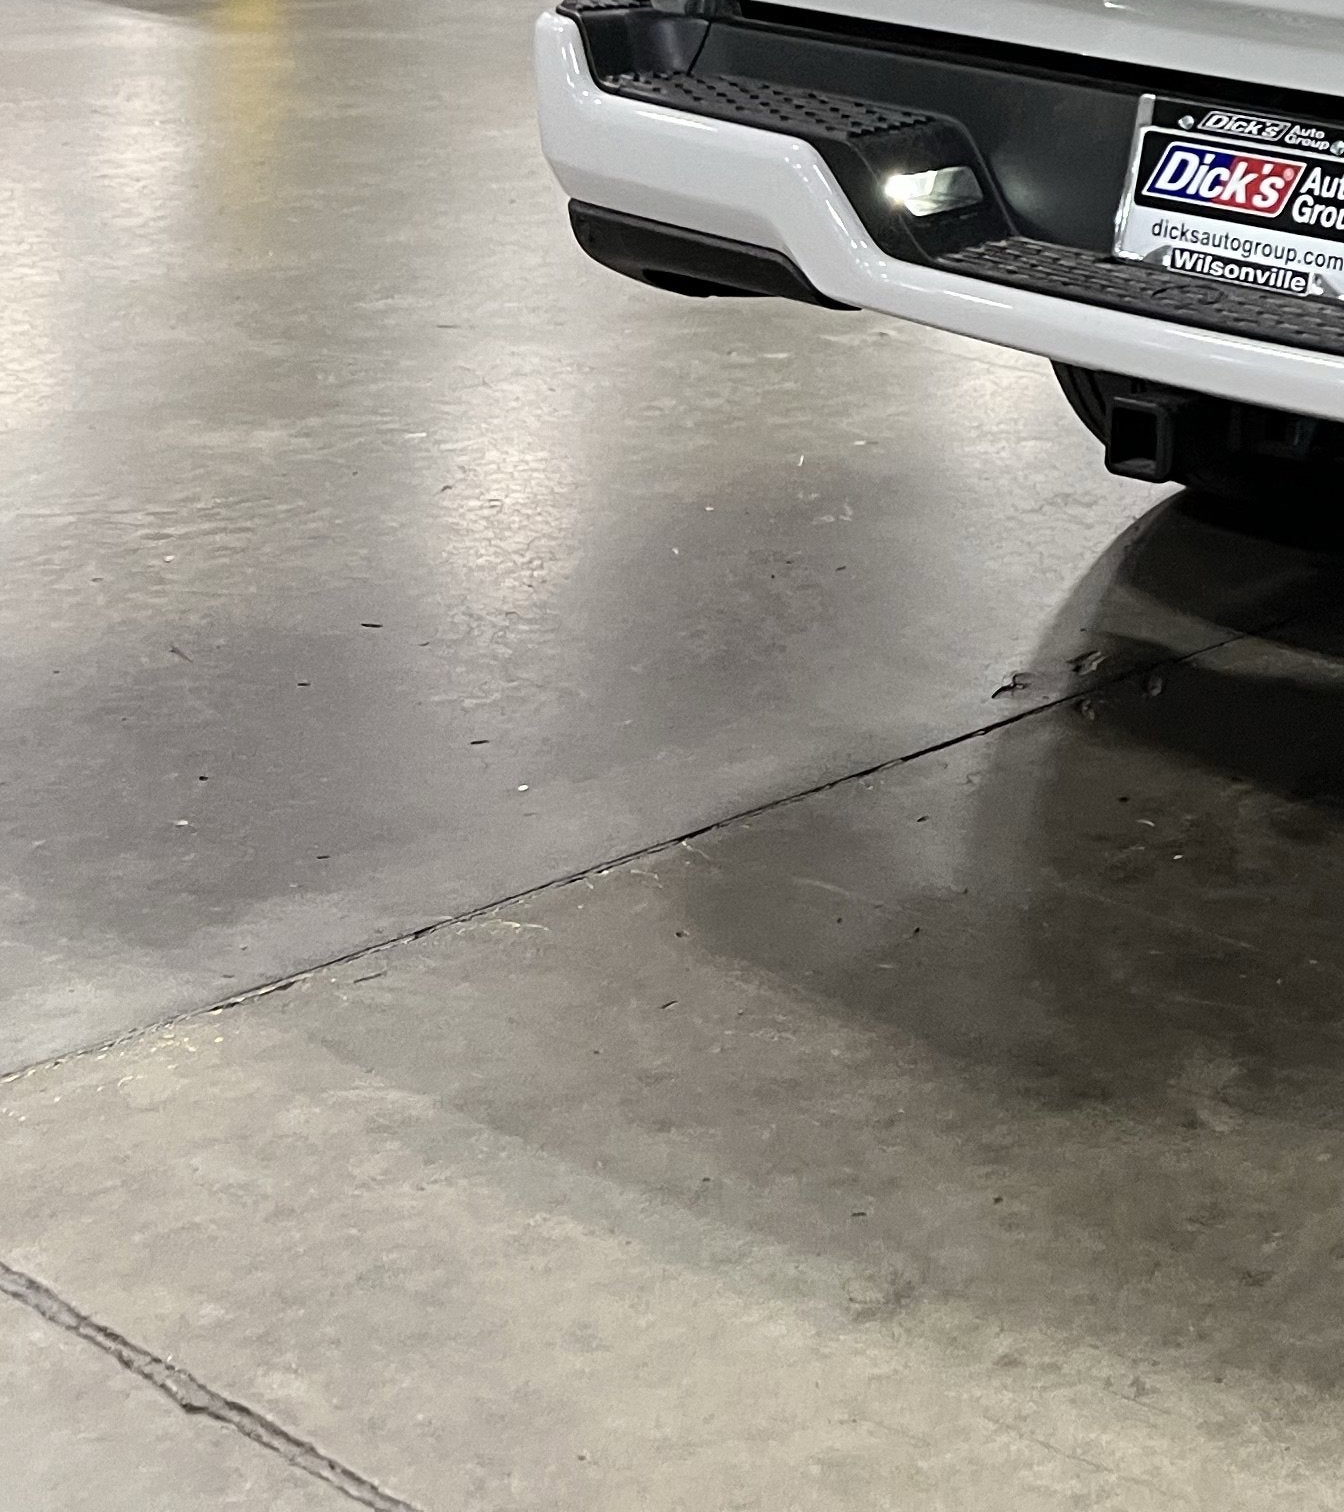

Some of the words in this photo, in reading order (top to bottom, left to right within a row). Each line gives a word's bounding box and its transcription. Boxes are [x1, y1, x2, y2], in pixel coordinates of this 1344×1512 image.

[1205, 112, 1282, 140] Dick's
[1284, 133, 1331, 151] Group
[1289, 125, 1326, 140] Auto
[1154, 149, 1288, 210] Dick's
[1151, 218, 1344, 272] dicksautogroup.com
[1171, 248, 1308, 294] Wilsonville
